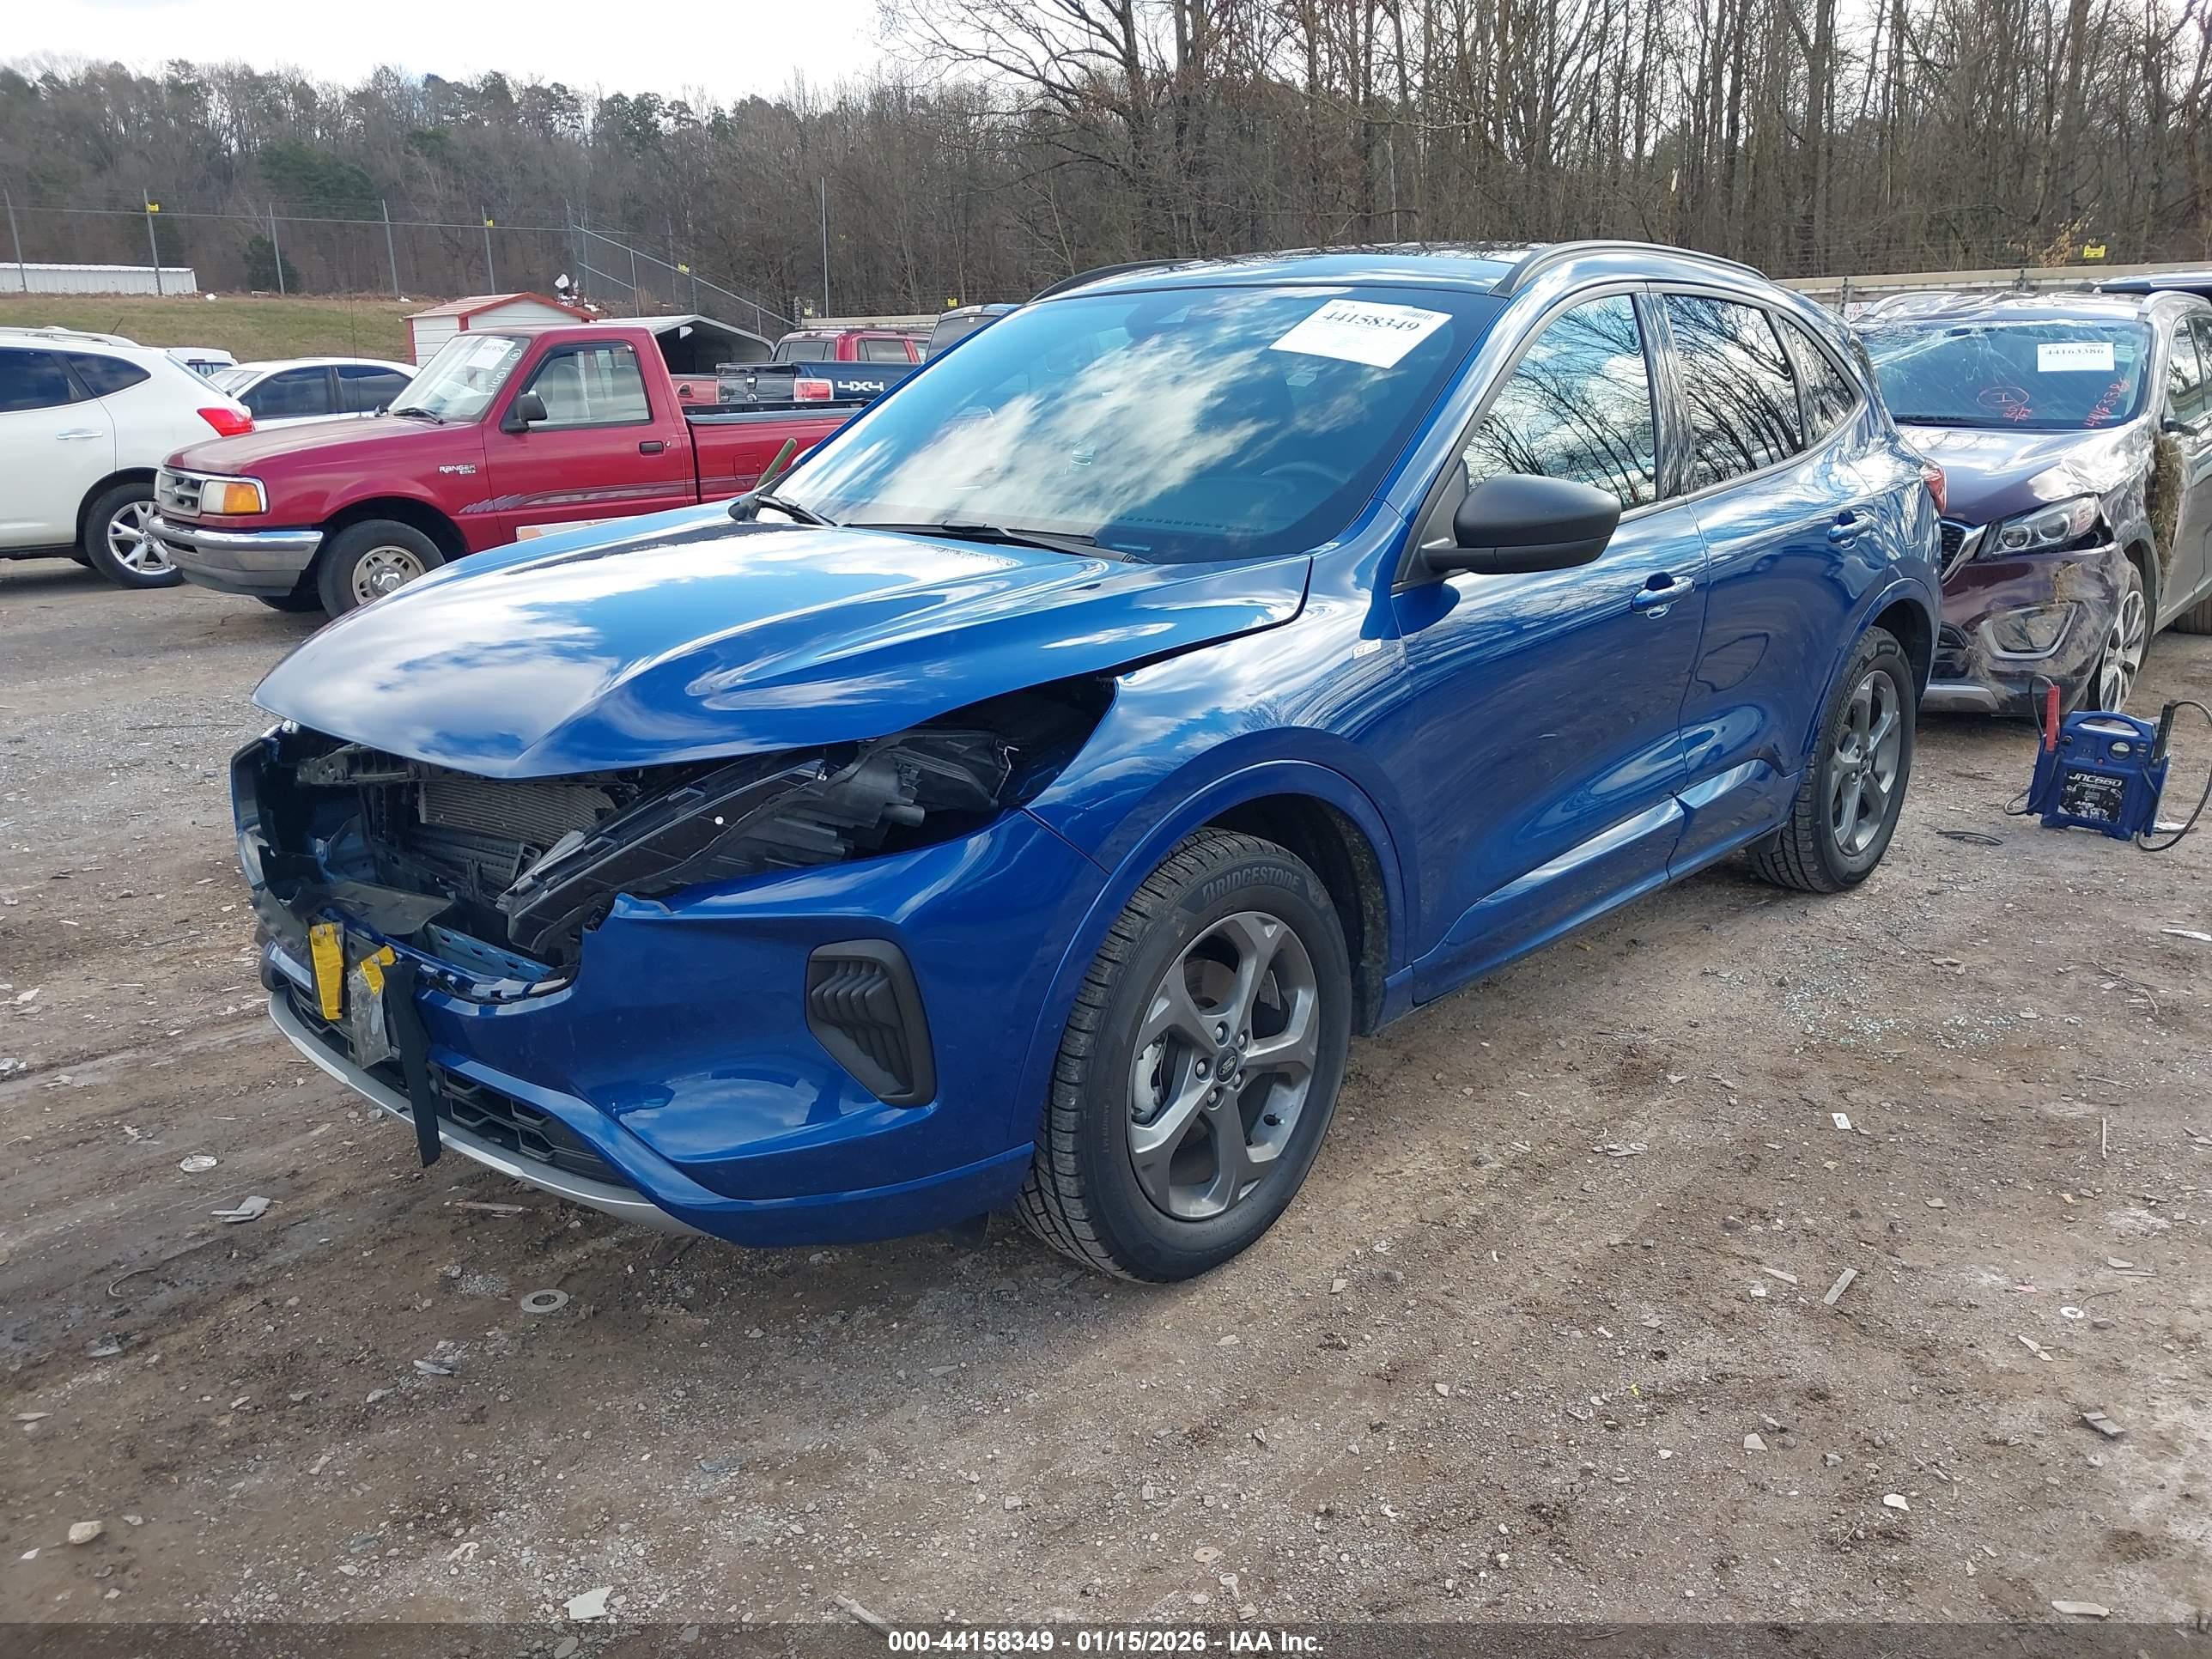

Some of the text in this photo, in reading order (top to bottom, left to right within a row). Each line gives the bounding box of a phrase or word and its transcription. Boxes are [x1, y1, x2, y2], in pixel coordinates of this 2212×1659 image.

[1322, 311, 1419, 332] 44158349
[837, 380, 884, 392] 4X4
[1202, 866, 1300, 902] BRIDGESTONE
